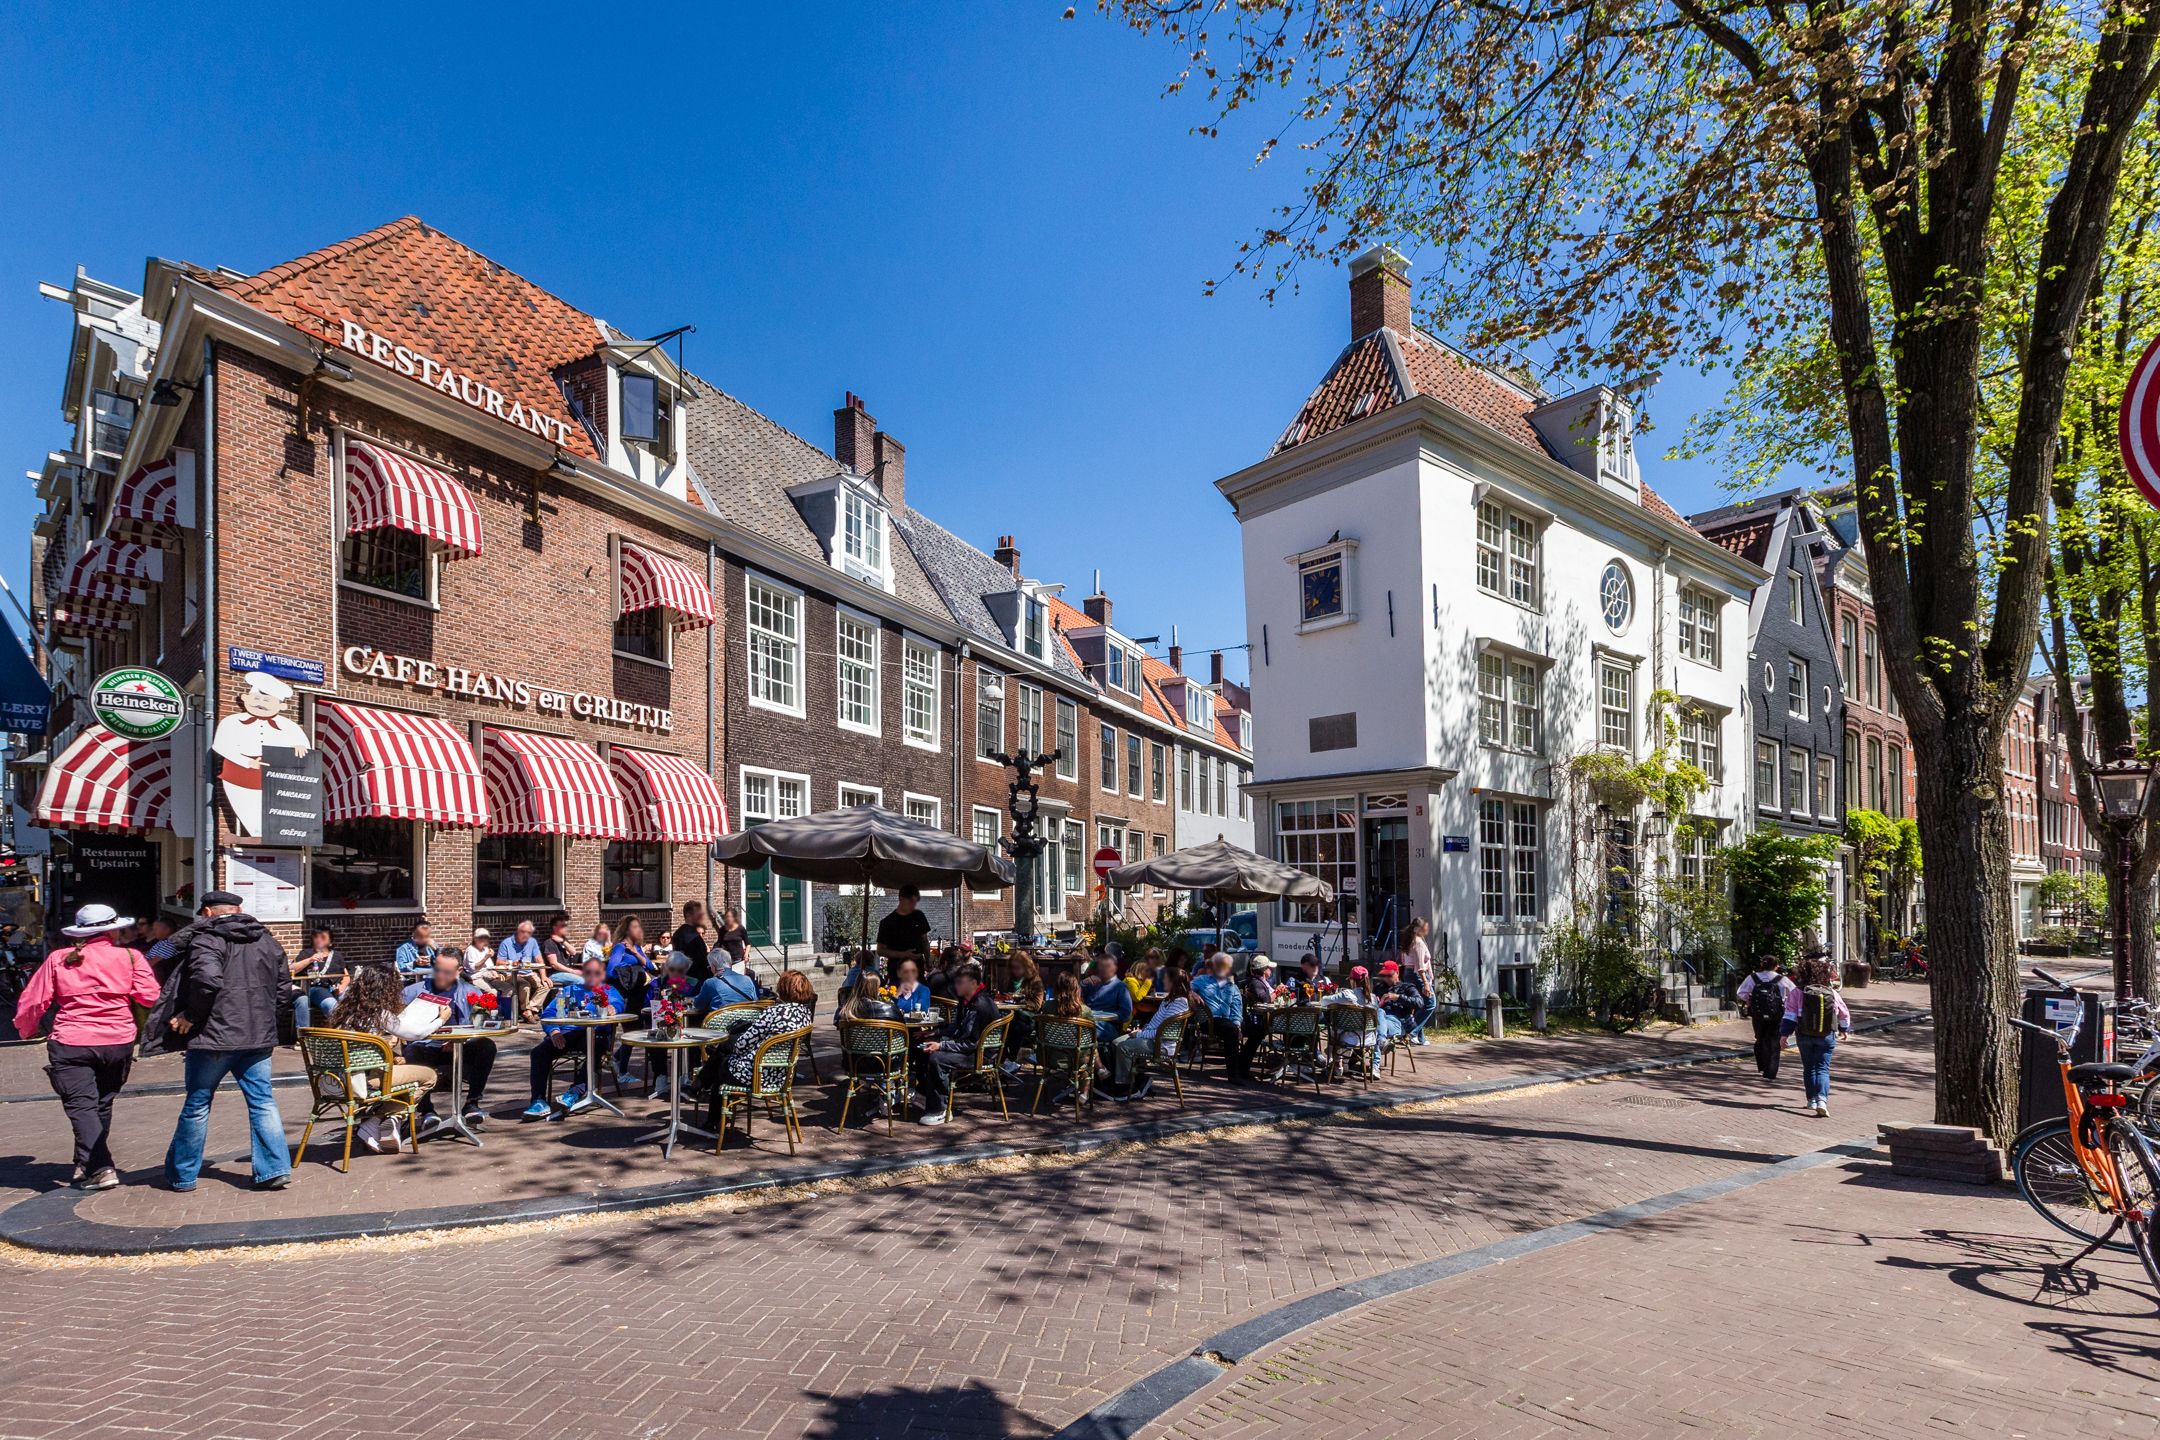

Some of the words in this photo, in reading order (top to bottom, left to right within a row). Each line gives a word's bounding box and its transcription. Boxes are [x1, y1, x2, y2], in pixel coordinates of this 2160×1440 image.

[340, 318, 572, 447] RESTAURANT
[233, 648, 263, 662] TWEEDE
[264, 654, 323, 672] WETERINGDWARS
[233, 657, 260, 669] STRAAT
[107, 673, 140, 687] HEINEKEN
[141, 674, 171, 693] PILSENER
[344, 646, 438, 689] CAFE
[448, 665, 531, 704] HANS
[539, 689, 567, 712] en
[573, 692, 674, 731] GRIETJE
[101, 693, 177, 713] Heineken
[106, 714, 140, 734] PREMIUM
[142, 719, 172, 734] QUALITY
[266, 770, 319, 784] PANNENKOEKEN
[276, 789, 312, 800] PANCAKES
[279, 828, 307, 838] CRÊPES
[81, 847, 147, 857] Restaurant
[1415, 847, 1425, 859] 31
[90, 859, 141, 870] Upstairs
